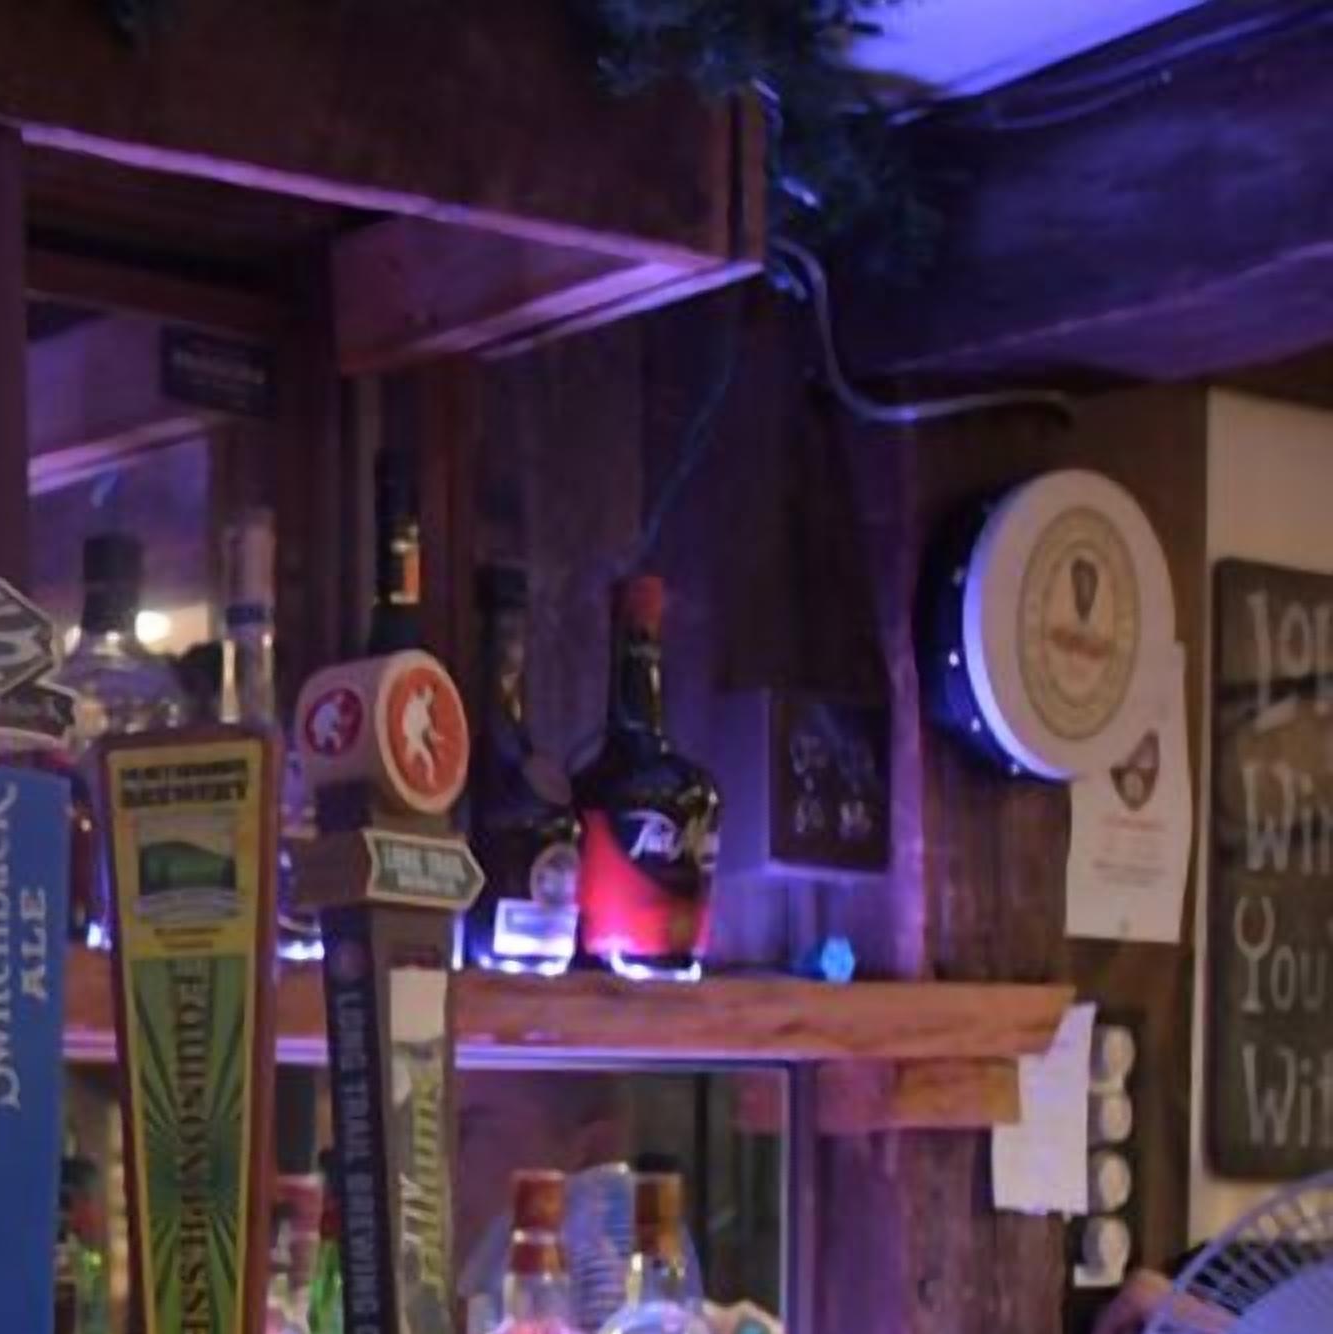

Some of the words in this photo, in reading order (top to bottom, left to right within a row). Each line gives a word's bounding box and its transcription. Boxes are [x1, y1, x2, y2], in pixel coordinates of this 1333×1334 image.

[21, 885, 48, 1003] ALE
[341, 1082, 372, 1161] TRAIL
[346, 1173, 380, 1314] BREWING
